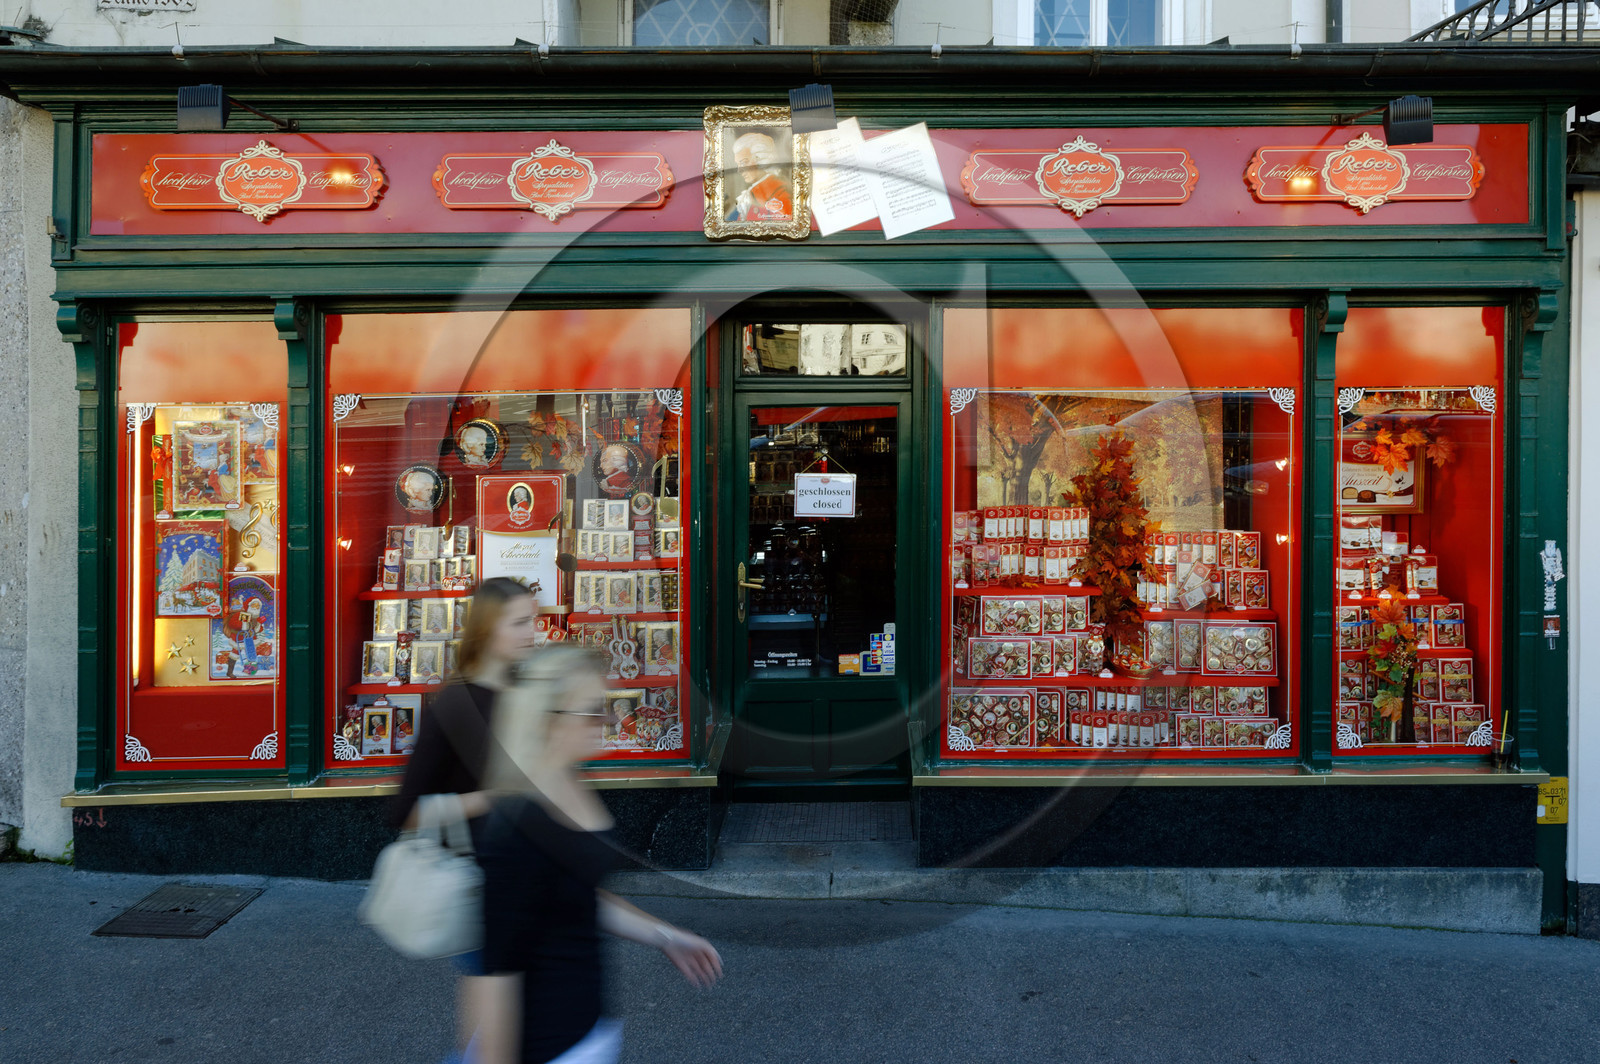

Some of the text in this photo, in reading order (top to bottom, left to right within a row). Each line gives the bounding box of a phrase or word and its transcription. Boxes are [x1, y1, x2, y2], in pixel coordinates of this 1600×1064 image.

[156, 172, 214, 190] hochfeine
[227, 163, 293, 182] Reber
[448, 162, 661, 190] hochfeine Reber Confiserien
[977, 158, 1187, 185] hochfeine Reber Confiserien
[1332, 155, 1397, 174] Reber
[1412, 163, 1473, 181] Confiserien
[799, 487, 851, 497] geschlossen
[812, 499, 842, 508] closed
